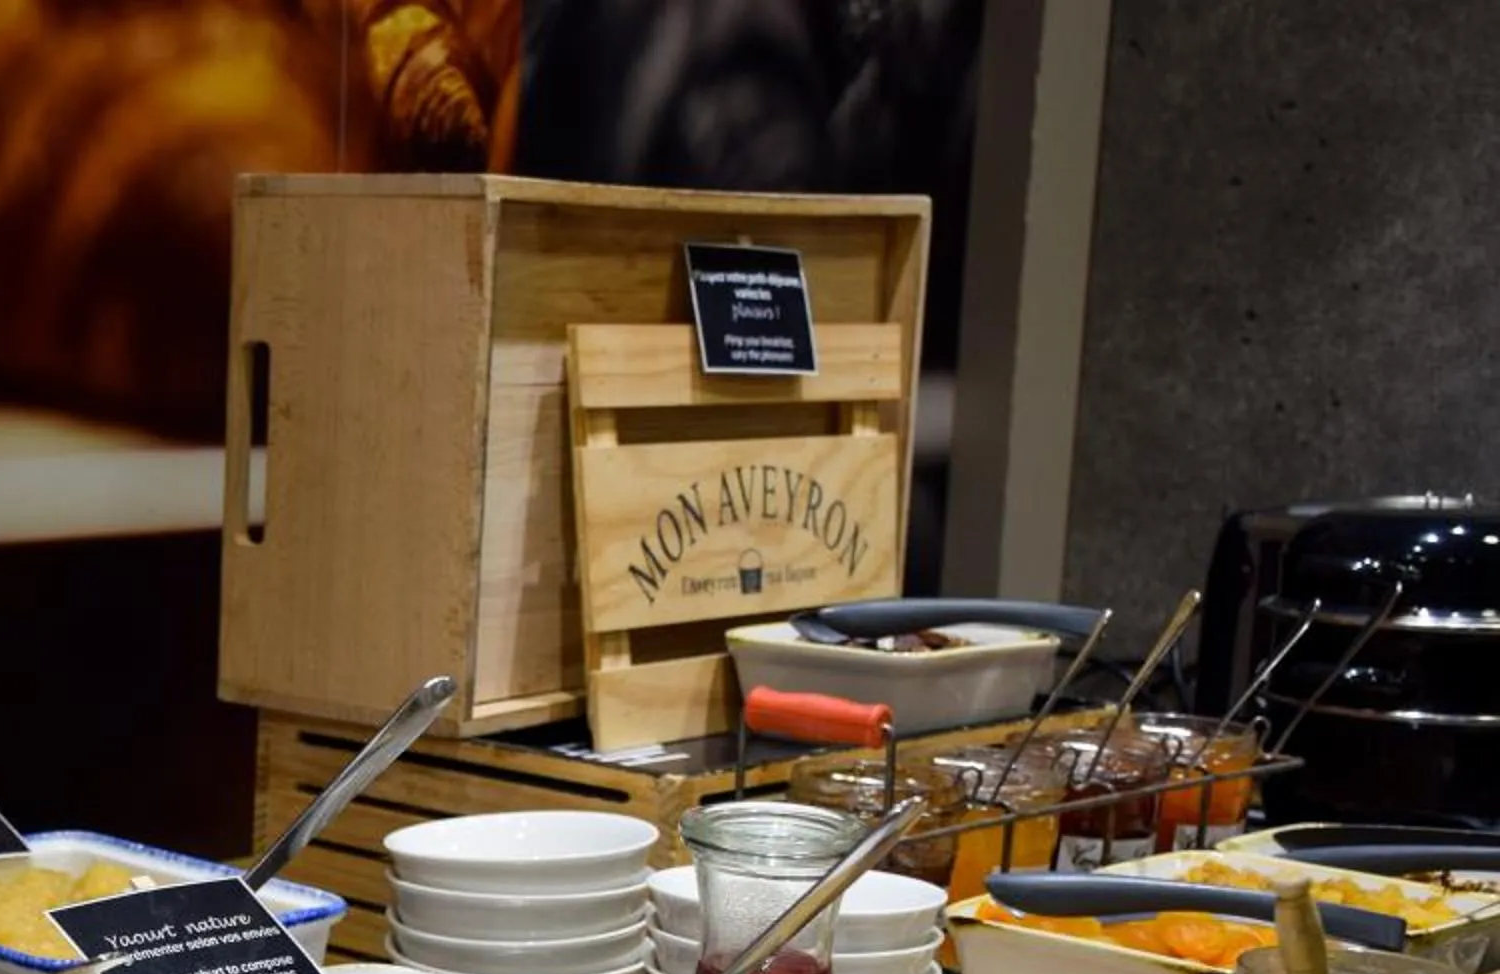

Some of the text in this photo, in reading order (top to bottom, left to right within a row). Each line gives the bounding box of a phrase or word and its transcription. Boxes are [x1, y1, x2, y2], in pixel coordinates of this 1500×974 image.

[628, 465, 868, 604] MON AVEYRON
[103, 913, 251, 950] Yaourt nature
[186, 937, 219, 952] selon
[221, 932, 242, 946] vos
[242, 925, 281, 941] envies
[241, 953, 295, 974] compose
